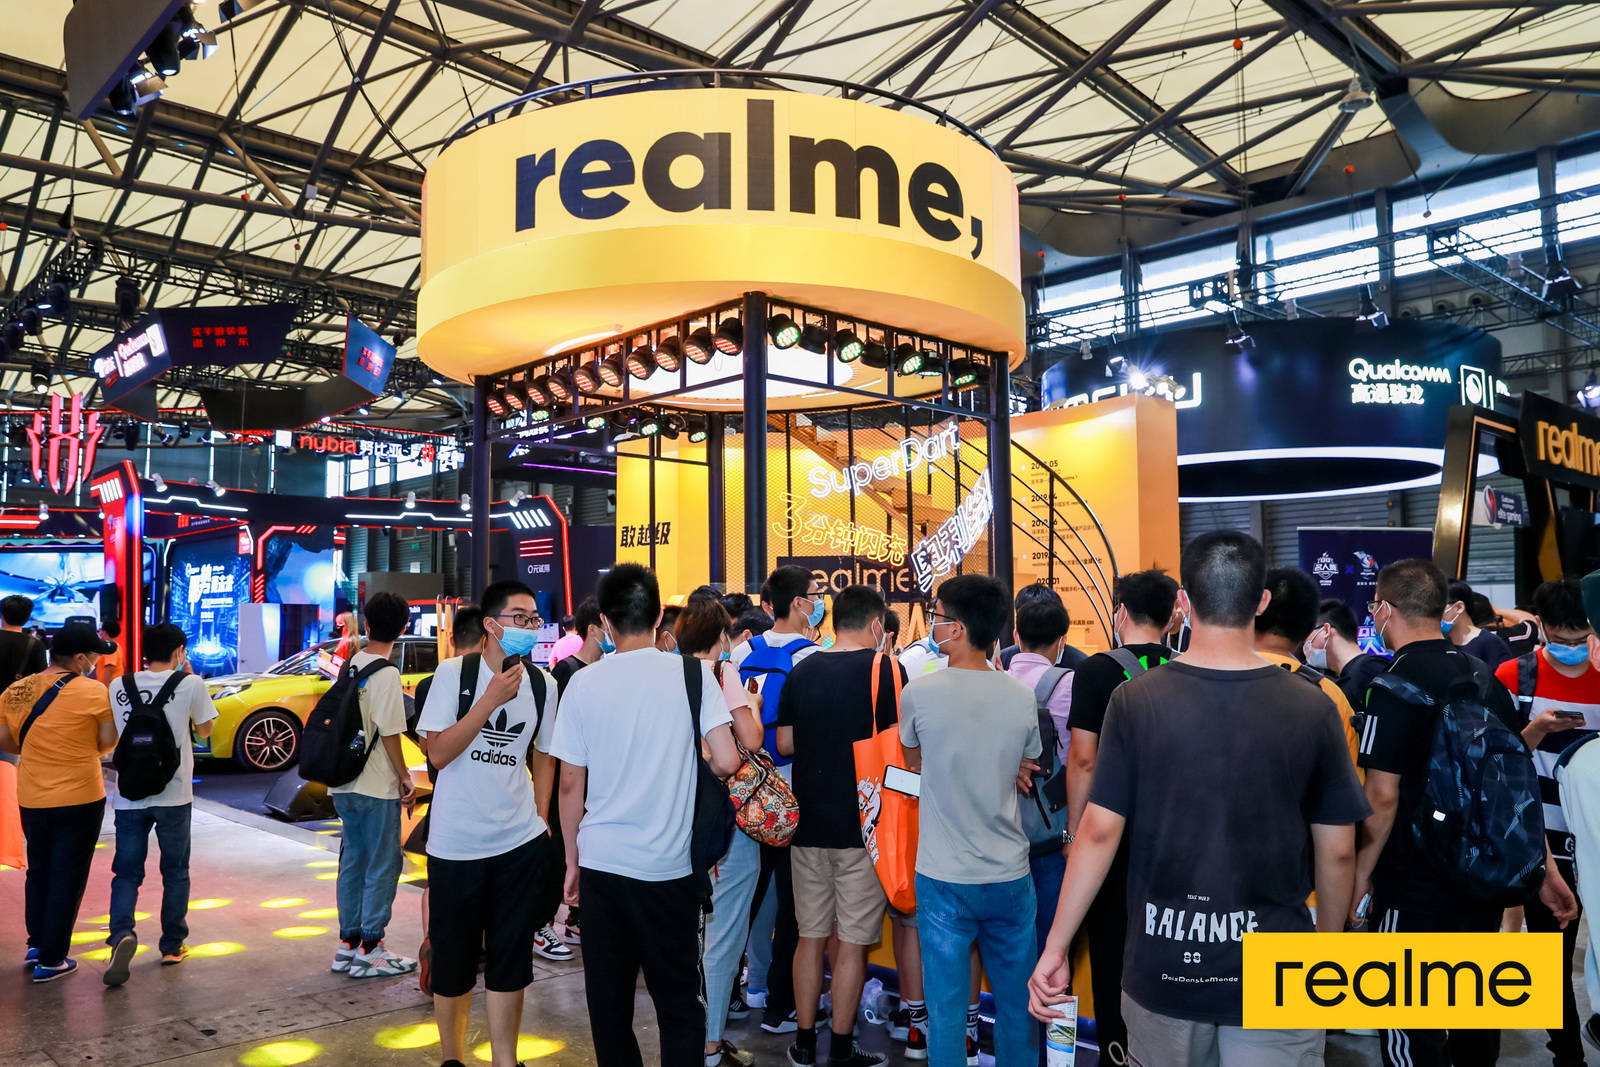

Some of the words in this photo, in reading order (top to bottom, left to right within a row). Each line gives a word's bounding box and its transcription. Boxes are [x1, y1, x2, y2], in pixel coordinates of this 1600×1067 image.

[516, 99, 983, 259] realme,
[1348, 358, 1452, 383] Qualcomm
[1350, 383, 1425, 404] 高通骁龙
[299, 435, 358, 454] nubia
[808, 421, 961, 498] SuperDart
[620, 522, 671, 548] 敢越级
[470, 749, 517, 766] adidas
[1145, 902, 1259, 943] BALANCE
